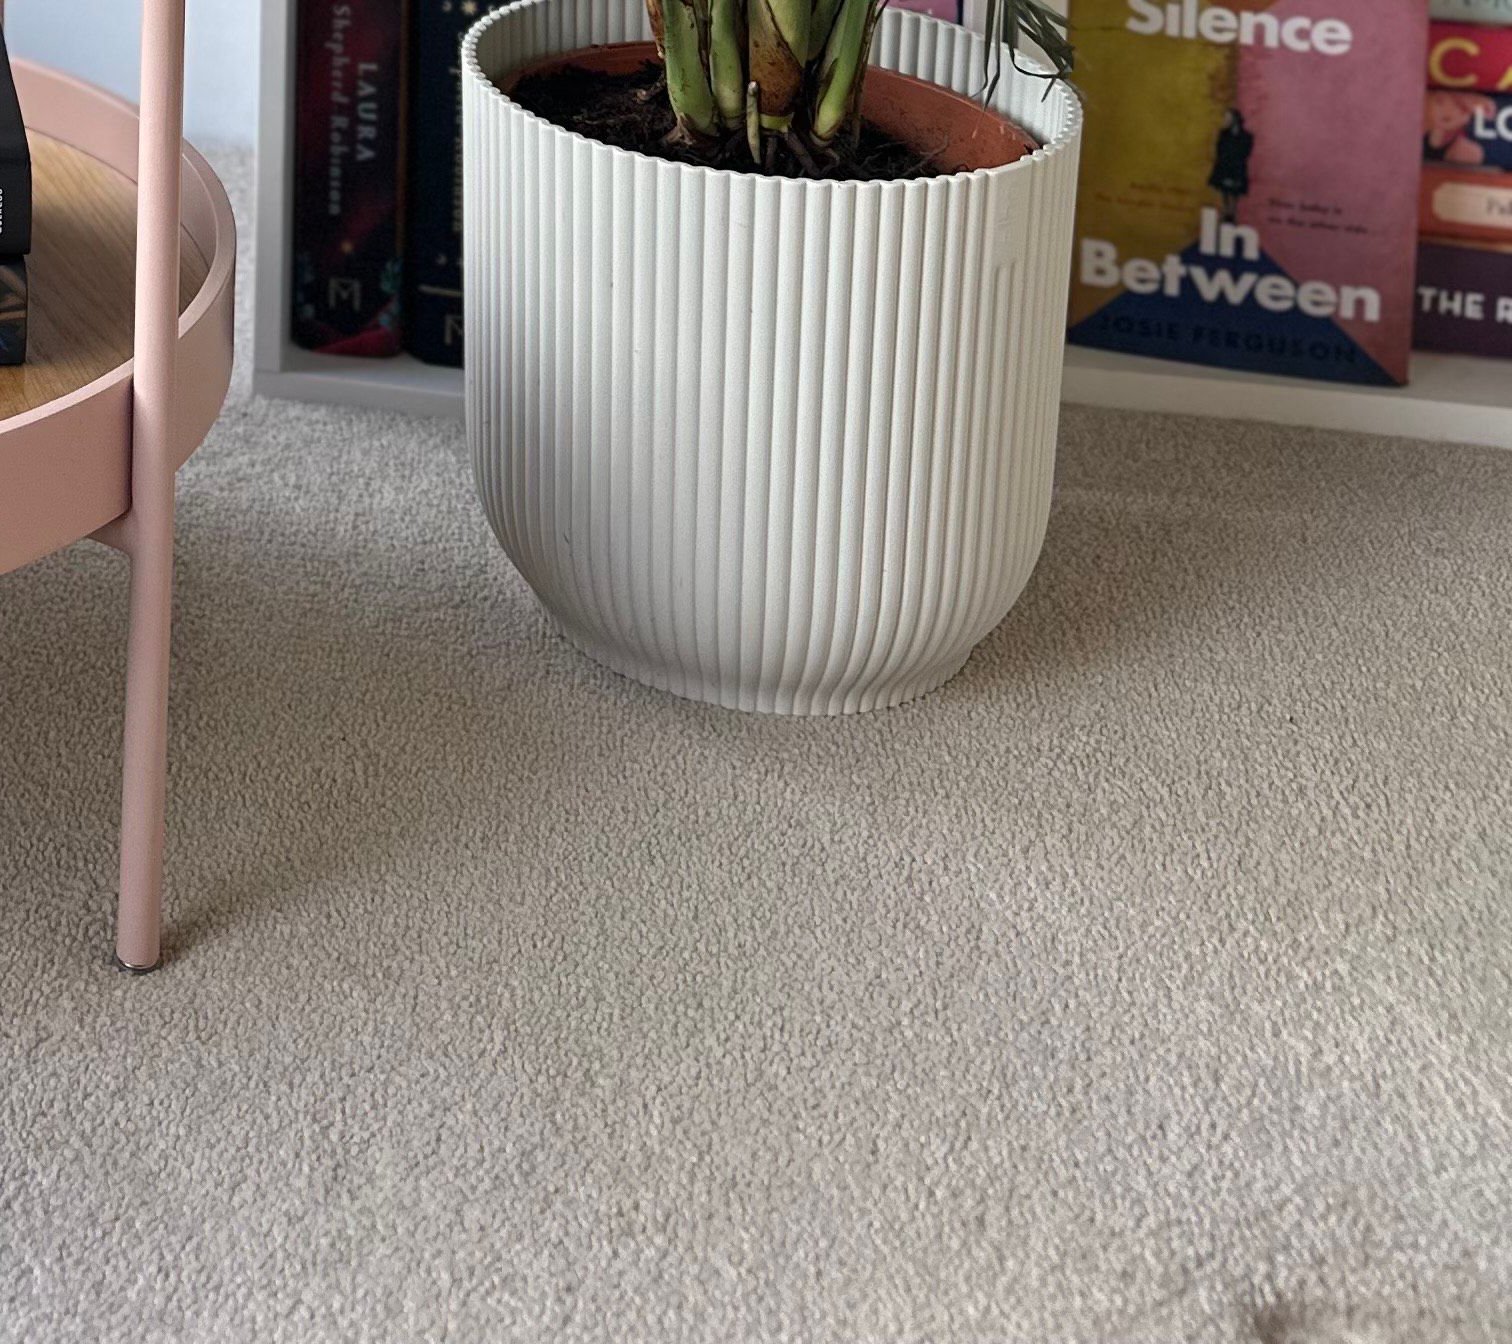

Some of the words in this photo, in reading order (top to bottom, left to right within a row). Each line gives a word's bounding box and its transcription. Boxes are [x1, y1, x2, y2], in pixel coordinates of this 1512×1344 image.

[356, 62, 379, 164] LAURA
[1197, 206, 1262, 262] In
[1079, 238, 1382, 324] Between
[1417, 287, 1485, 320] THE
